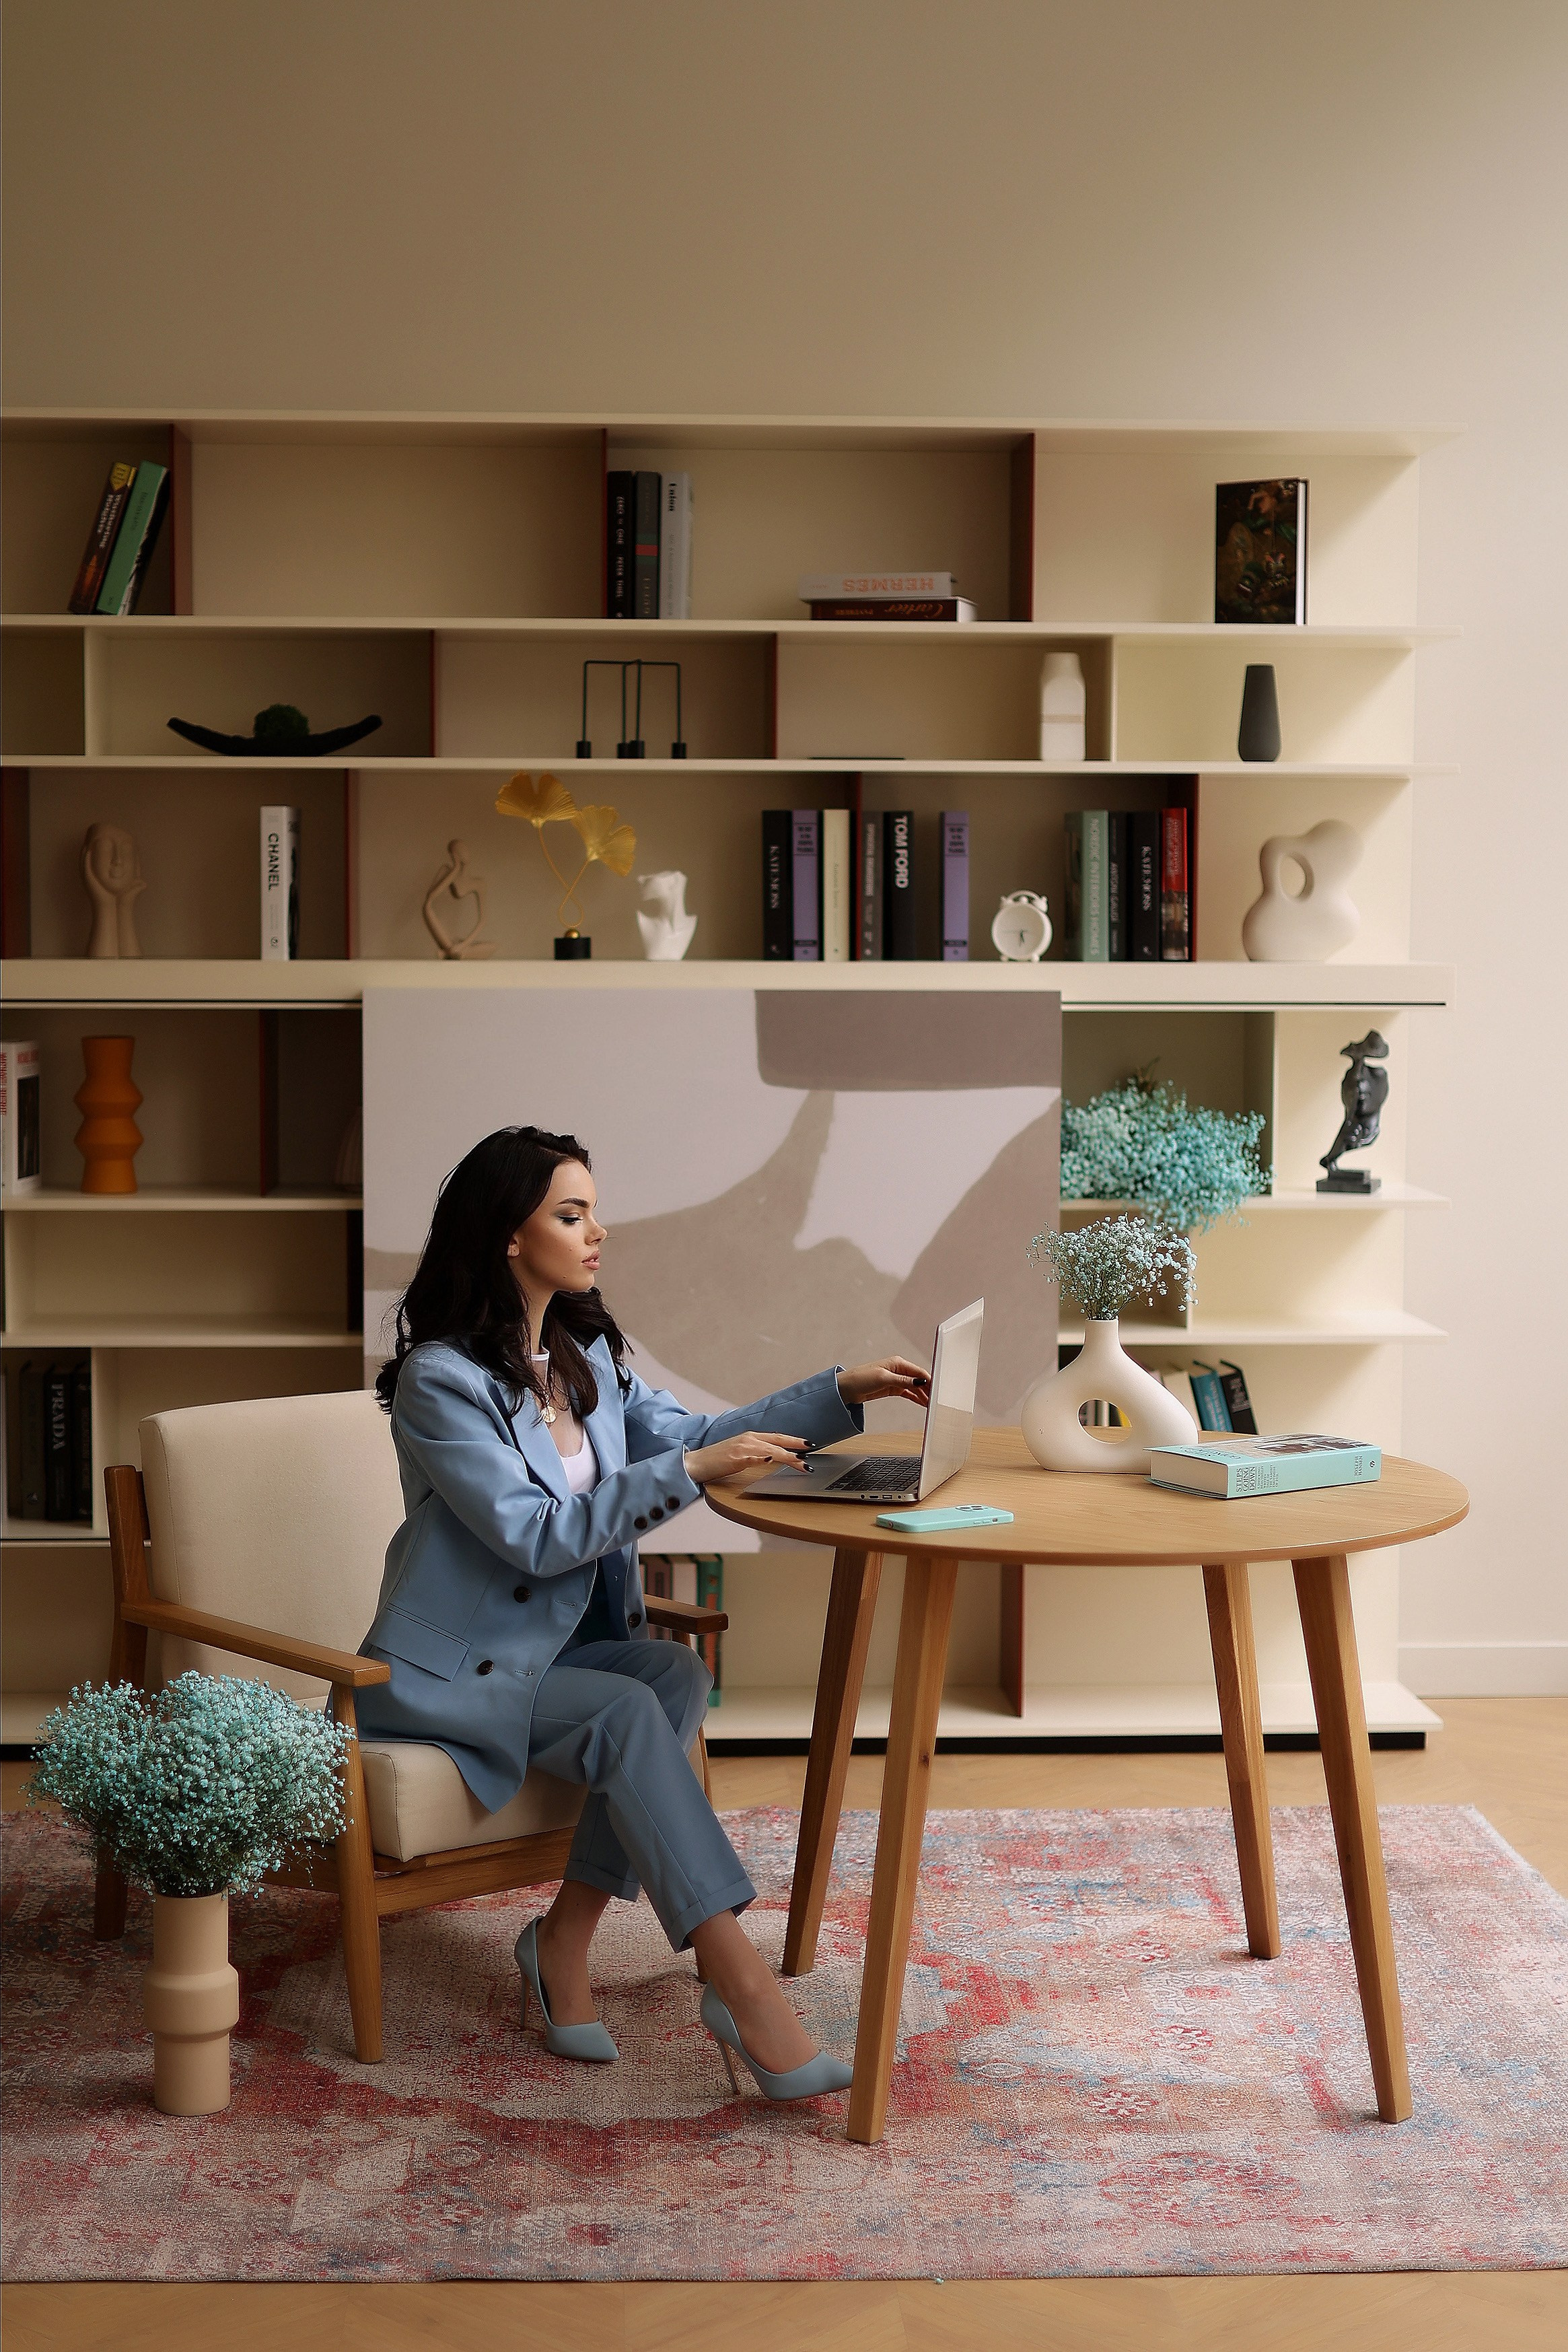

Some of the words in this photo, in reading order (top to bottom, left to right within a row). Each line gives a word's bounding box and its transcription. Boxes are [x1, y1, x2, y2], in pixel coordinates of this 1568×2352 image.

[894, 815, 909, 847] TOM
[268, 833, 280, 891] CHANEL
[894, 849, 909, 889] FORD
[51, 1383, 65, 1450] PRADA
